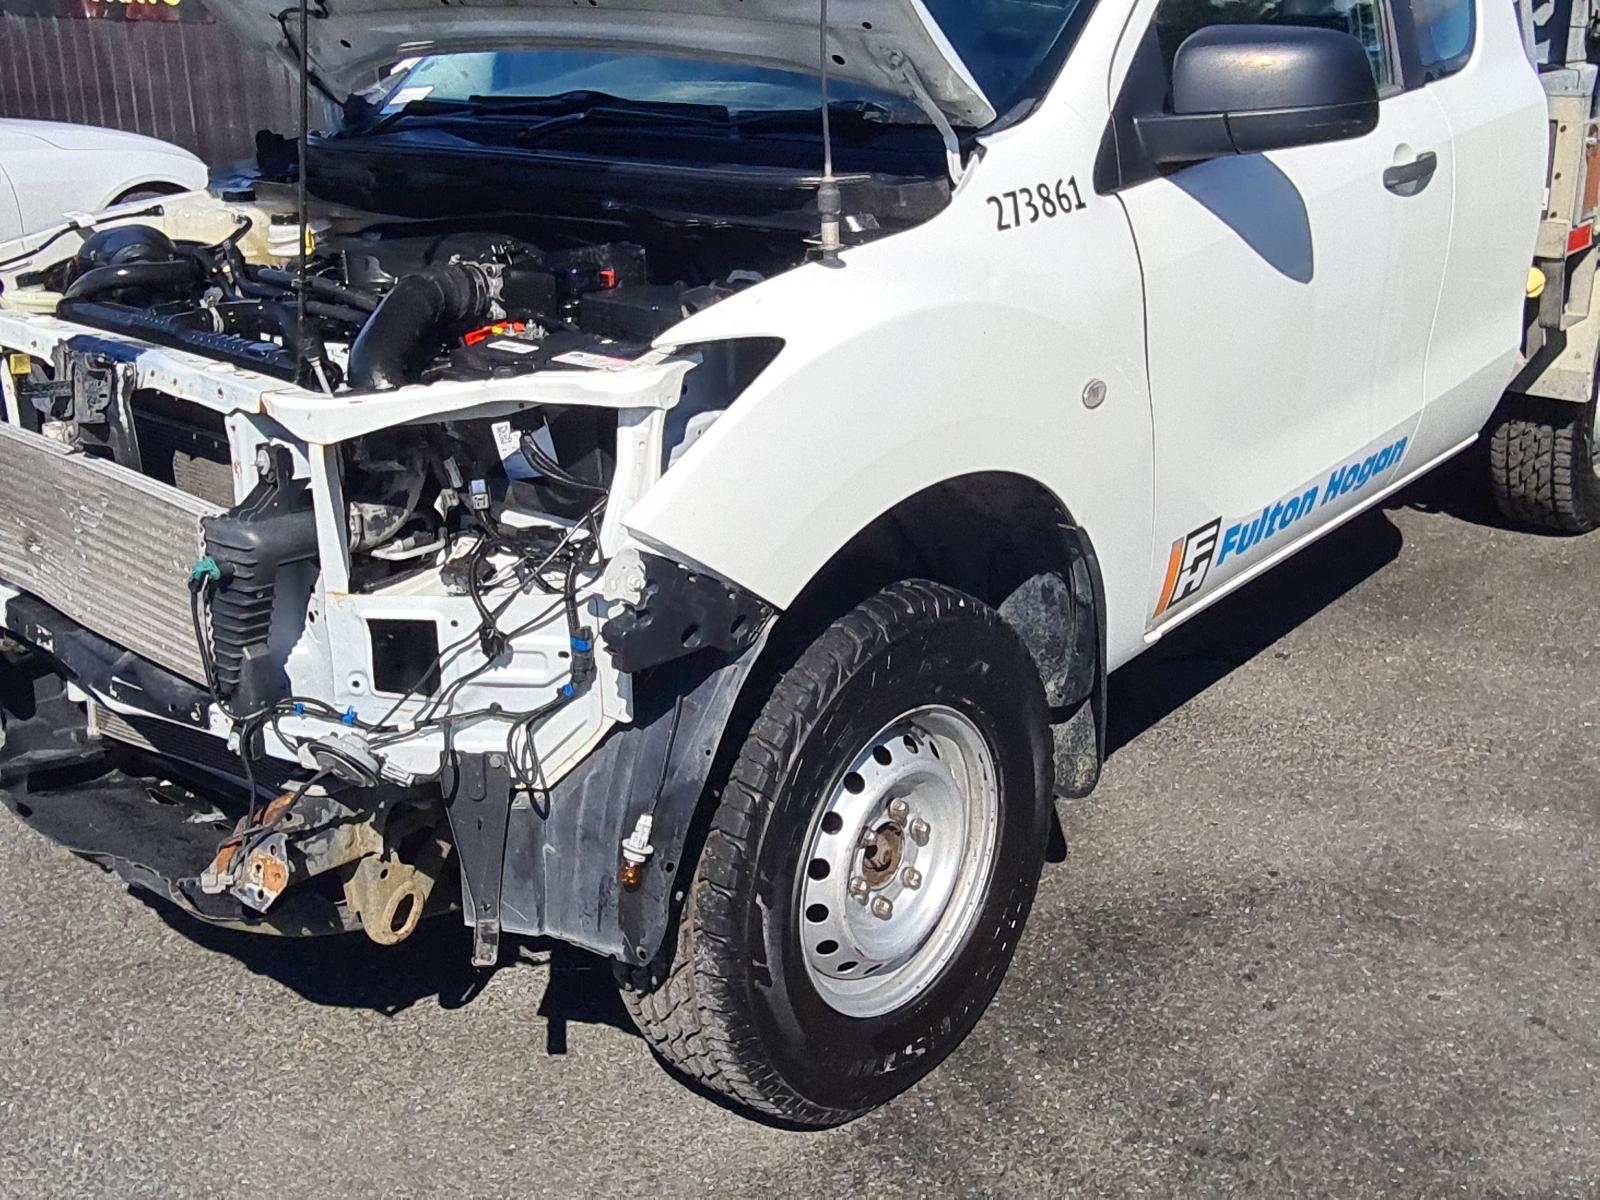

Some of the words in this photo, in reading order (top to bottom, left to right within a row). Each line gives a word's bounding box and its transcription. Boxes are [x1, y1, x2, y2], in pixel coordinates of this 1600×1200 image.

[985, 174, 1088, 232] 273861
[1215, 484, 1320, 568] Fulton
[1319, 435, 1409, 508] Hogan
